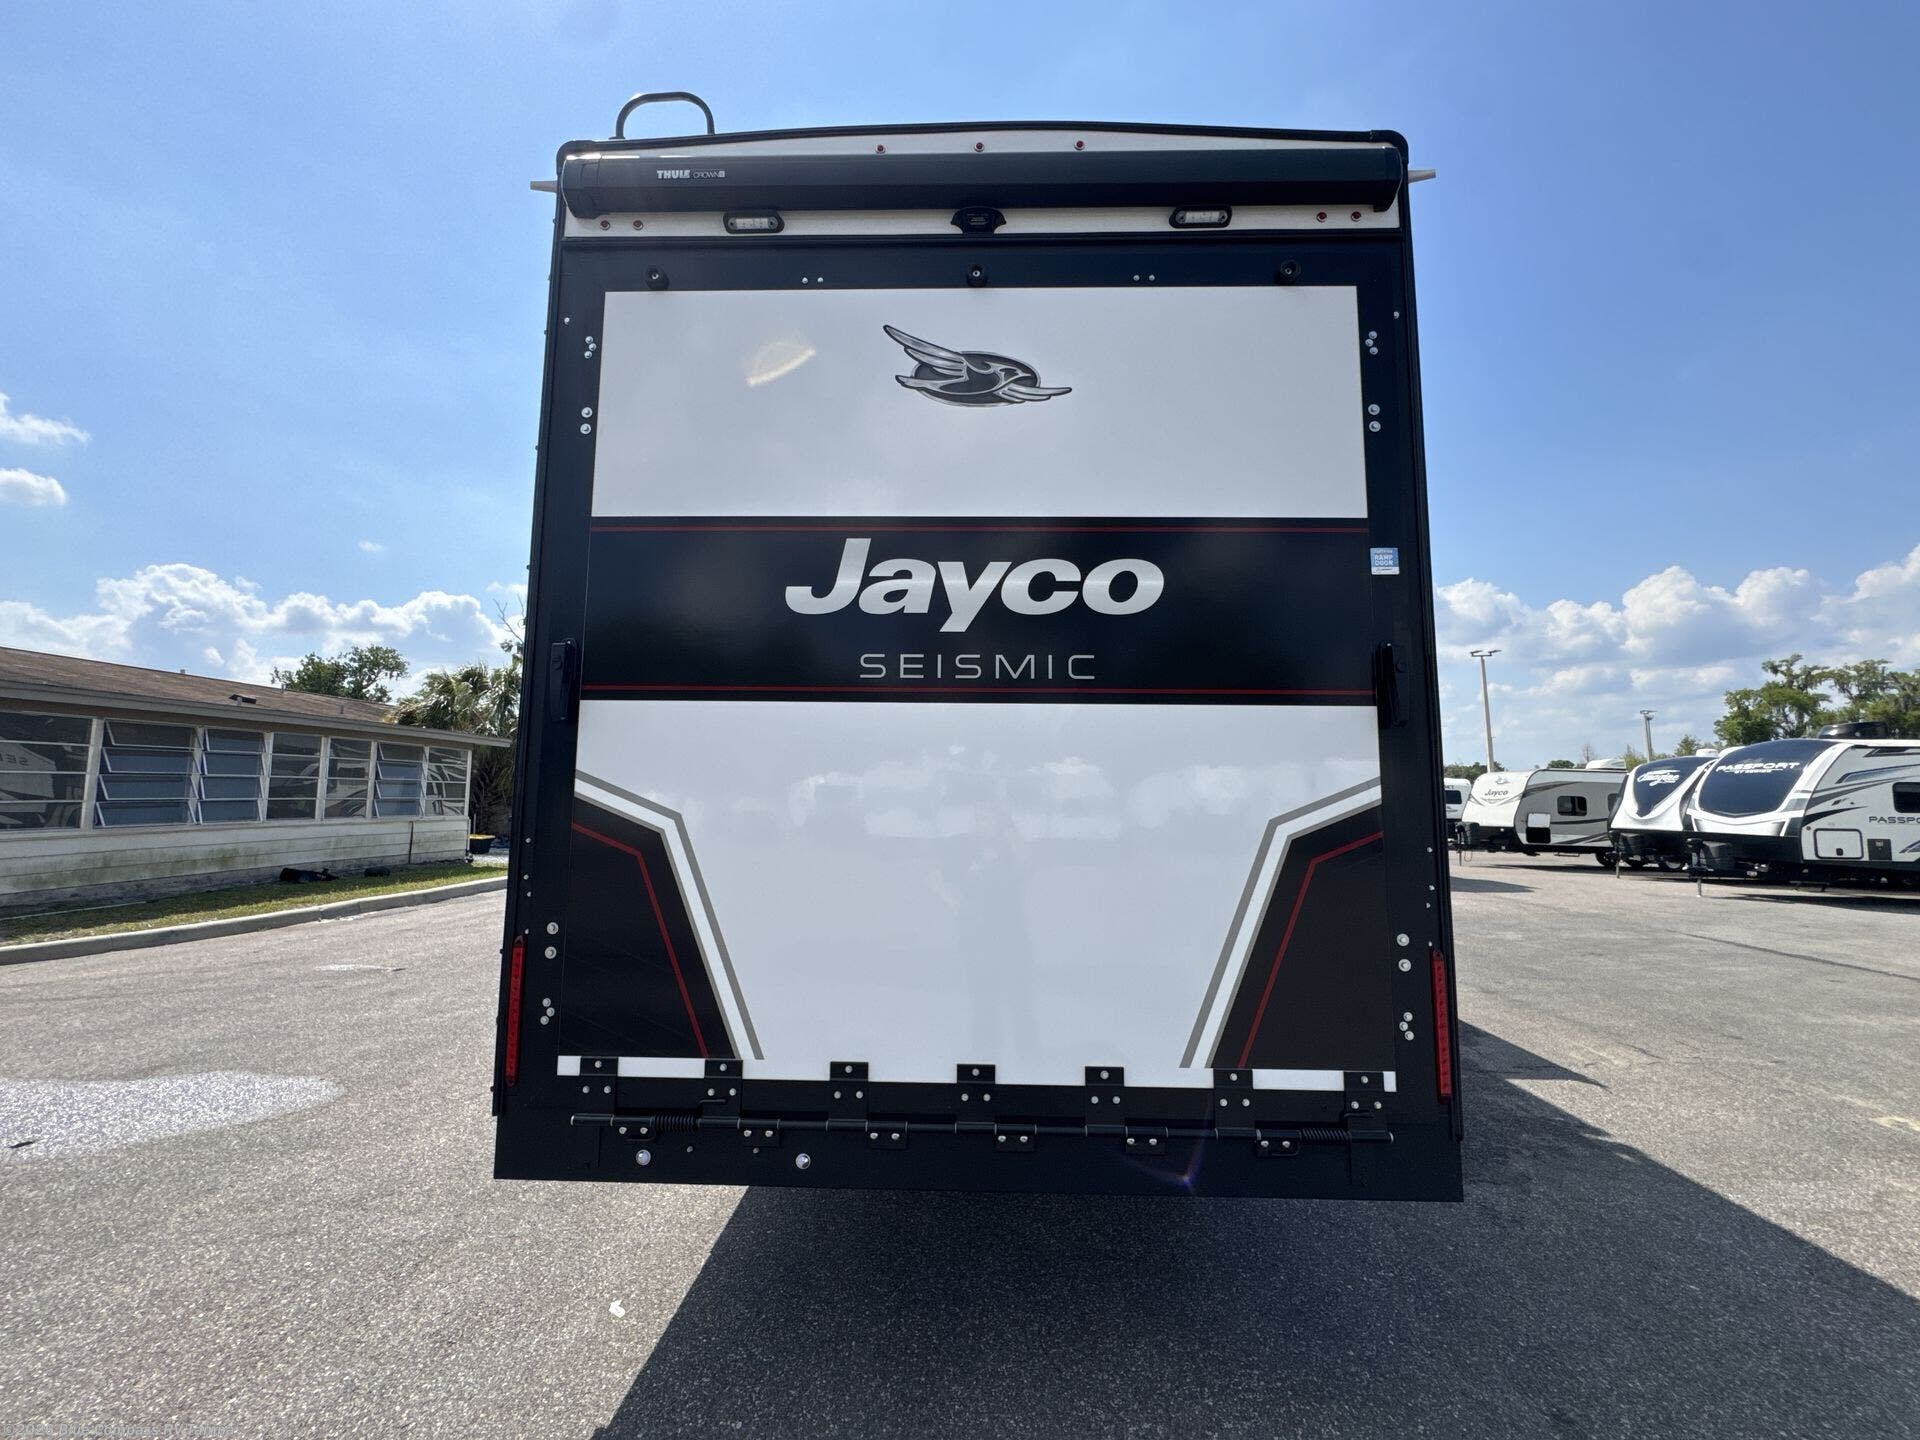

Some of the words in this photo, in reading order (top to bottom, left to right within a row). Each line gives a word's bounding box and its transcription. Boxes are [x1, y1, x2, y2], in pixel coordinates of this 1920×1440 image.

[657, 169, 691, 179] THULE
[785, 538, 1165, 633] Jayco
[860, 653, 1096, 681] SEISMIC
[1716, 762, 1799, 772] PASSPORT
[1484, 789, 1508, 797] Jayco
